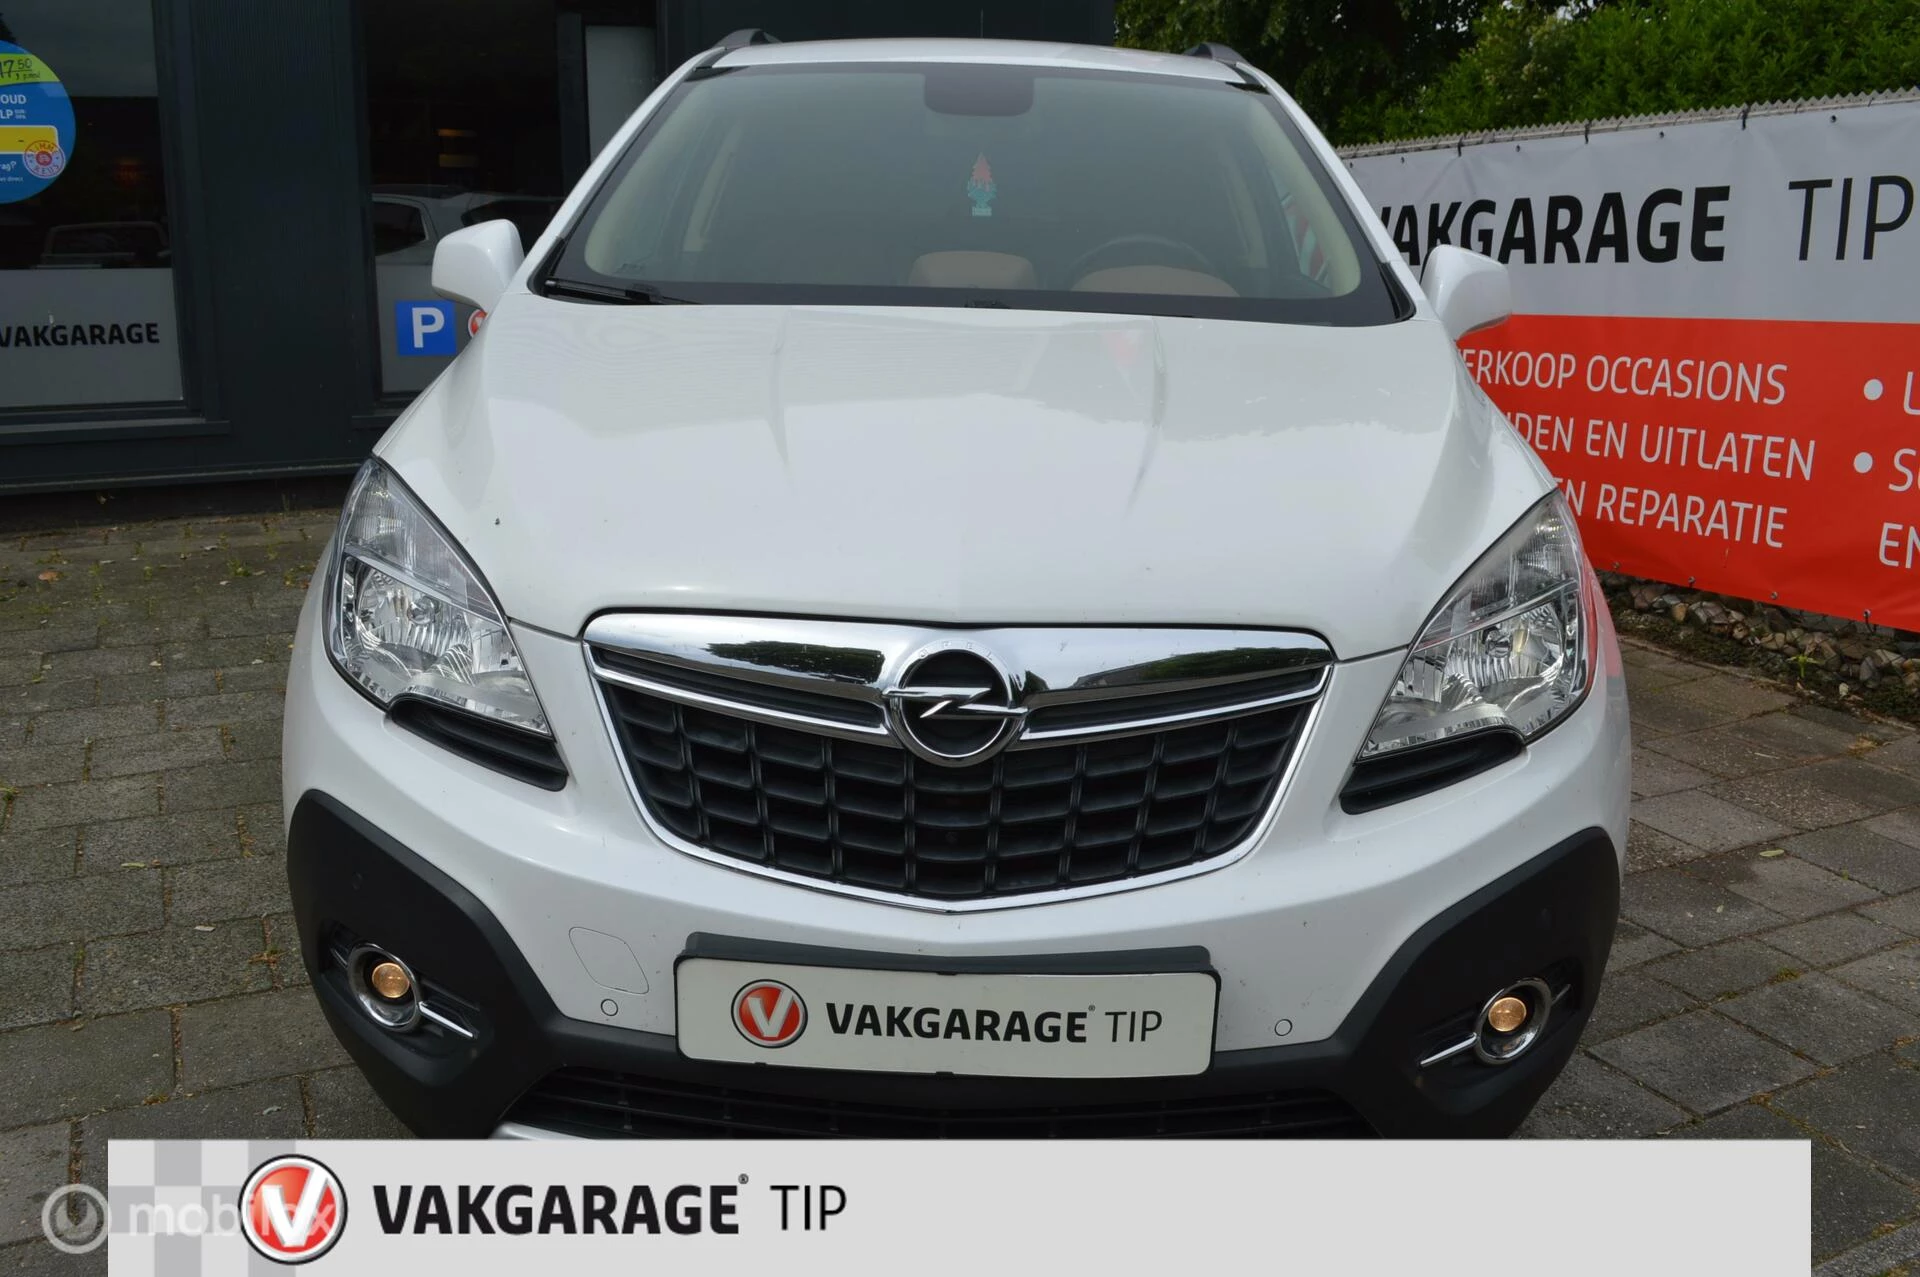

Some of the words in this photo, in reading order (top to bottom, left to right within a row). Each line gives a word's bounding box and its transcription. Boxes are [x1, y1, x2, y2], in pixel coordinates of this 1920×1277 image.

[1788, 175, 1914, 261] TIP
[0, 322, 160, 348] VAKGARAGE
[412, 307, 445, 348] P
[1458, 348, 1577, 390] ERKOOP
[1586, 354, 1788, 405] OCCASIONS
[1586, 418, 1628, 460] EN
[1640, 424, 1816, 481] UITLATEN
[1888, 447, 1920, 492] S
[1596, 483, 1788, 548] REPARATIE
[1105, 1010, 1163, 1042] TIP
